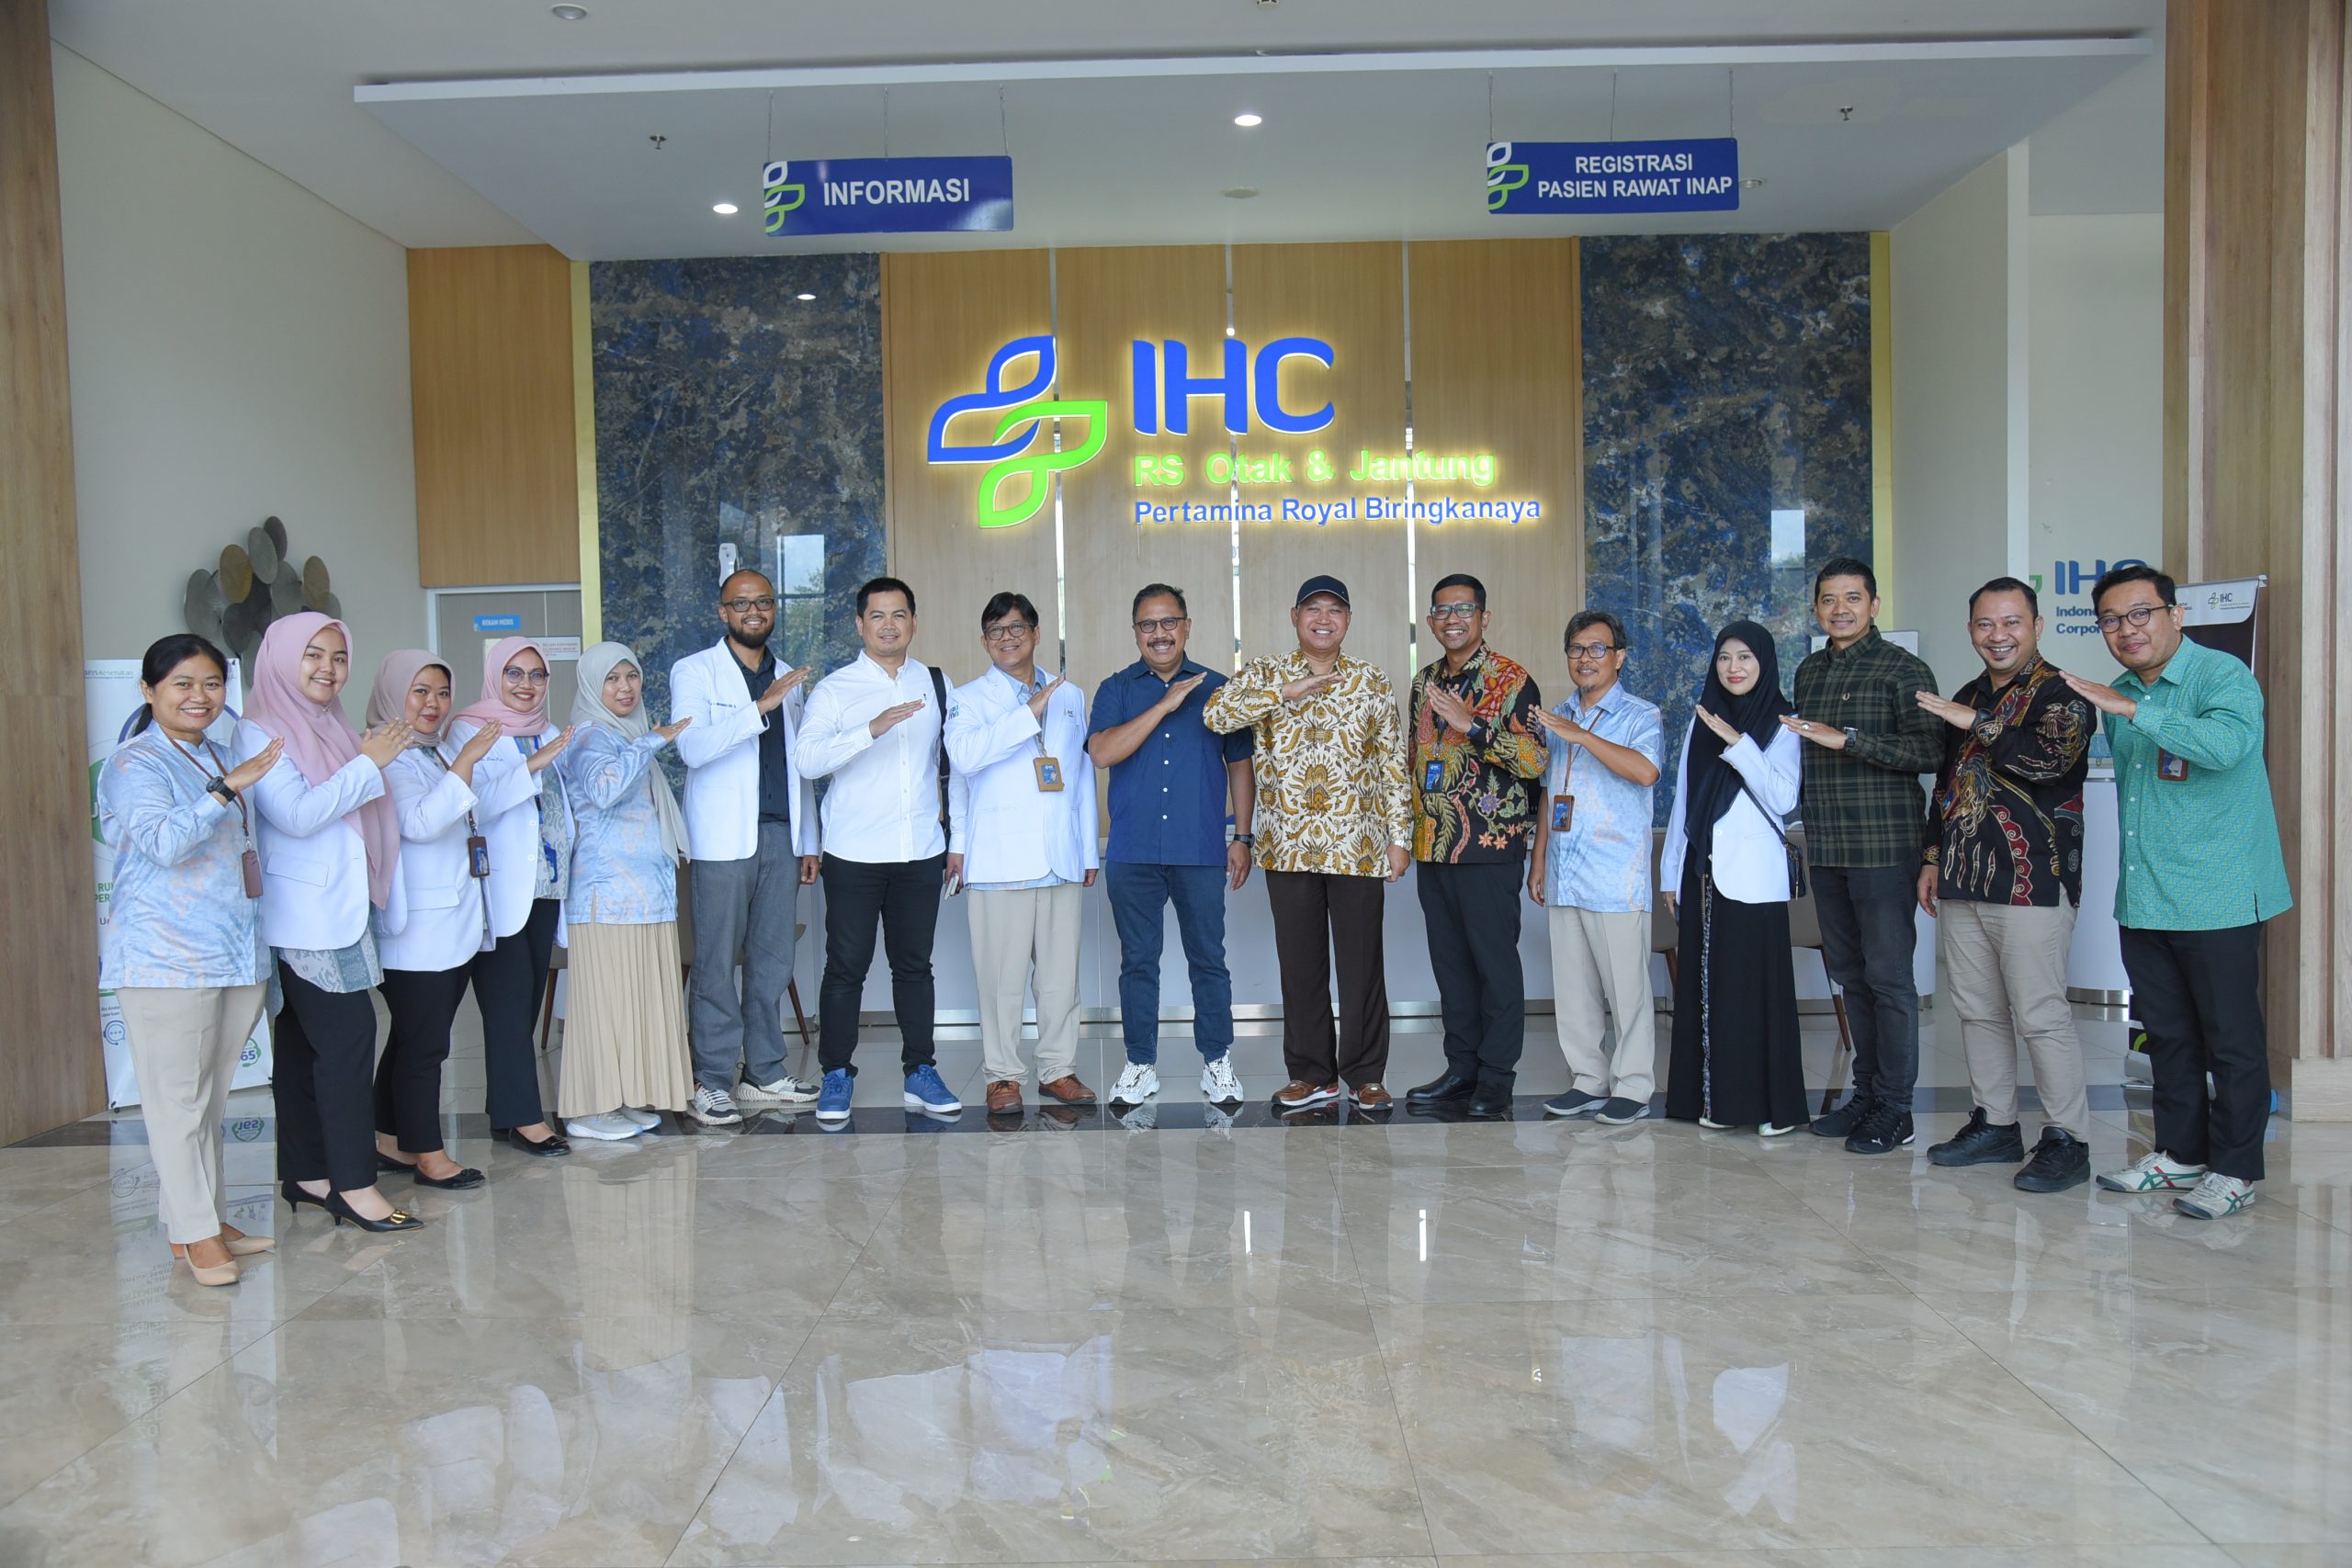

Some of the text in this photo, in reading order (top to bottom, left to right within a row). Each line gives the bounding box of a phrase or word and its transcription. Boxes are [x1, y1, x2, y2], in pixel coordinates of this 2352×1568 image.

[1575, 153, 1693, 174] REGISTRASI
[823, 178, 969, 206] INFORMASI
[1537, 175, 1734, 198] PASIEN RAWAT INAP
[1133, 336, 1335, 436] IHC
[1134, 449, 1496, 486] RS Otak & Jantung
[1135, 496, 1542, 526] Pertamina Royal Biringkanaya
[2054, 559, 2147, 595] IH
[2220, 592, 2233, 603] IHC
